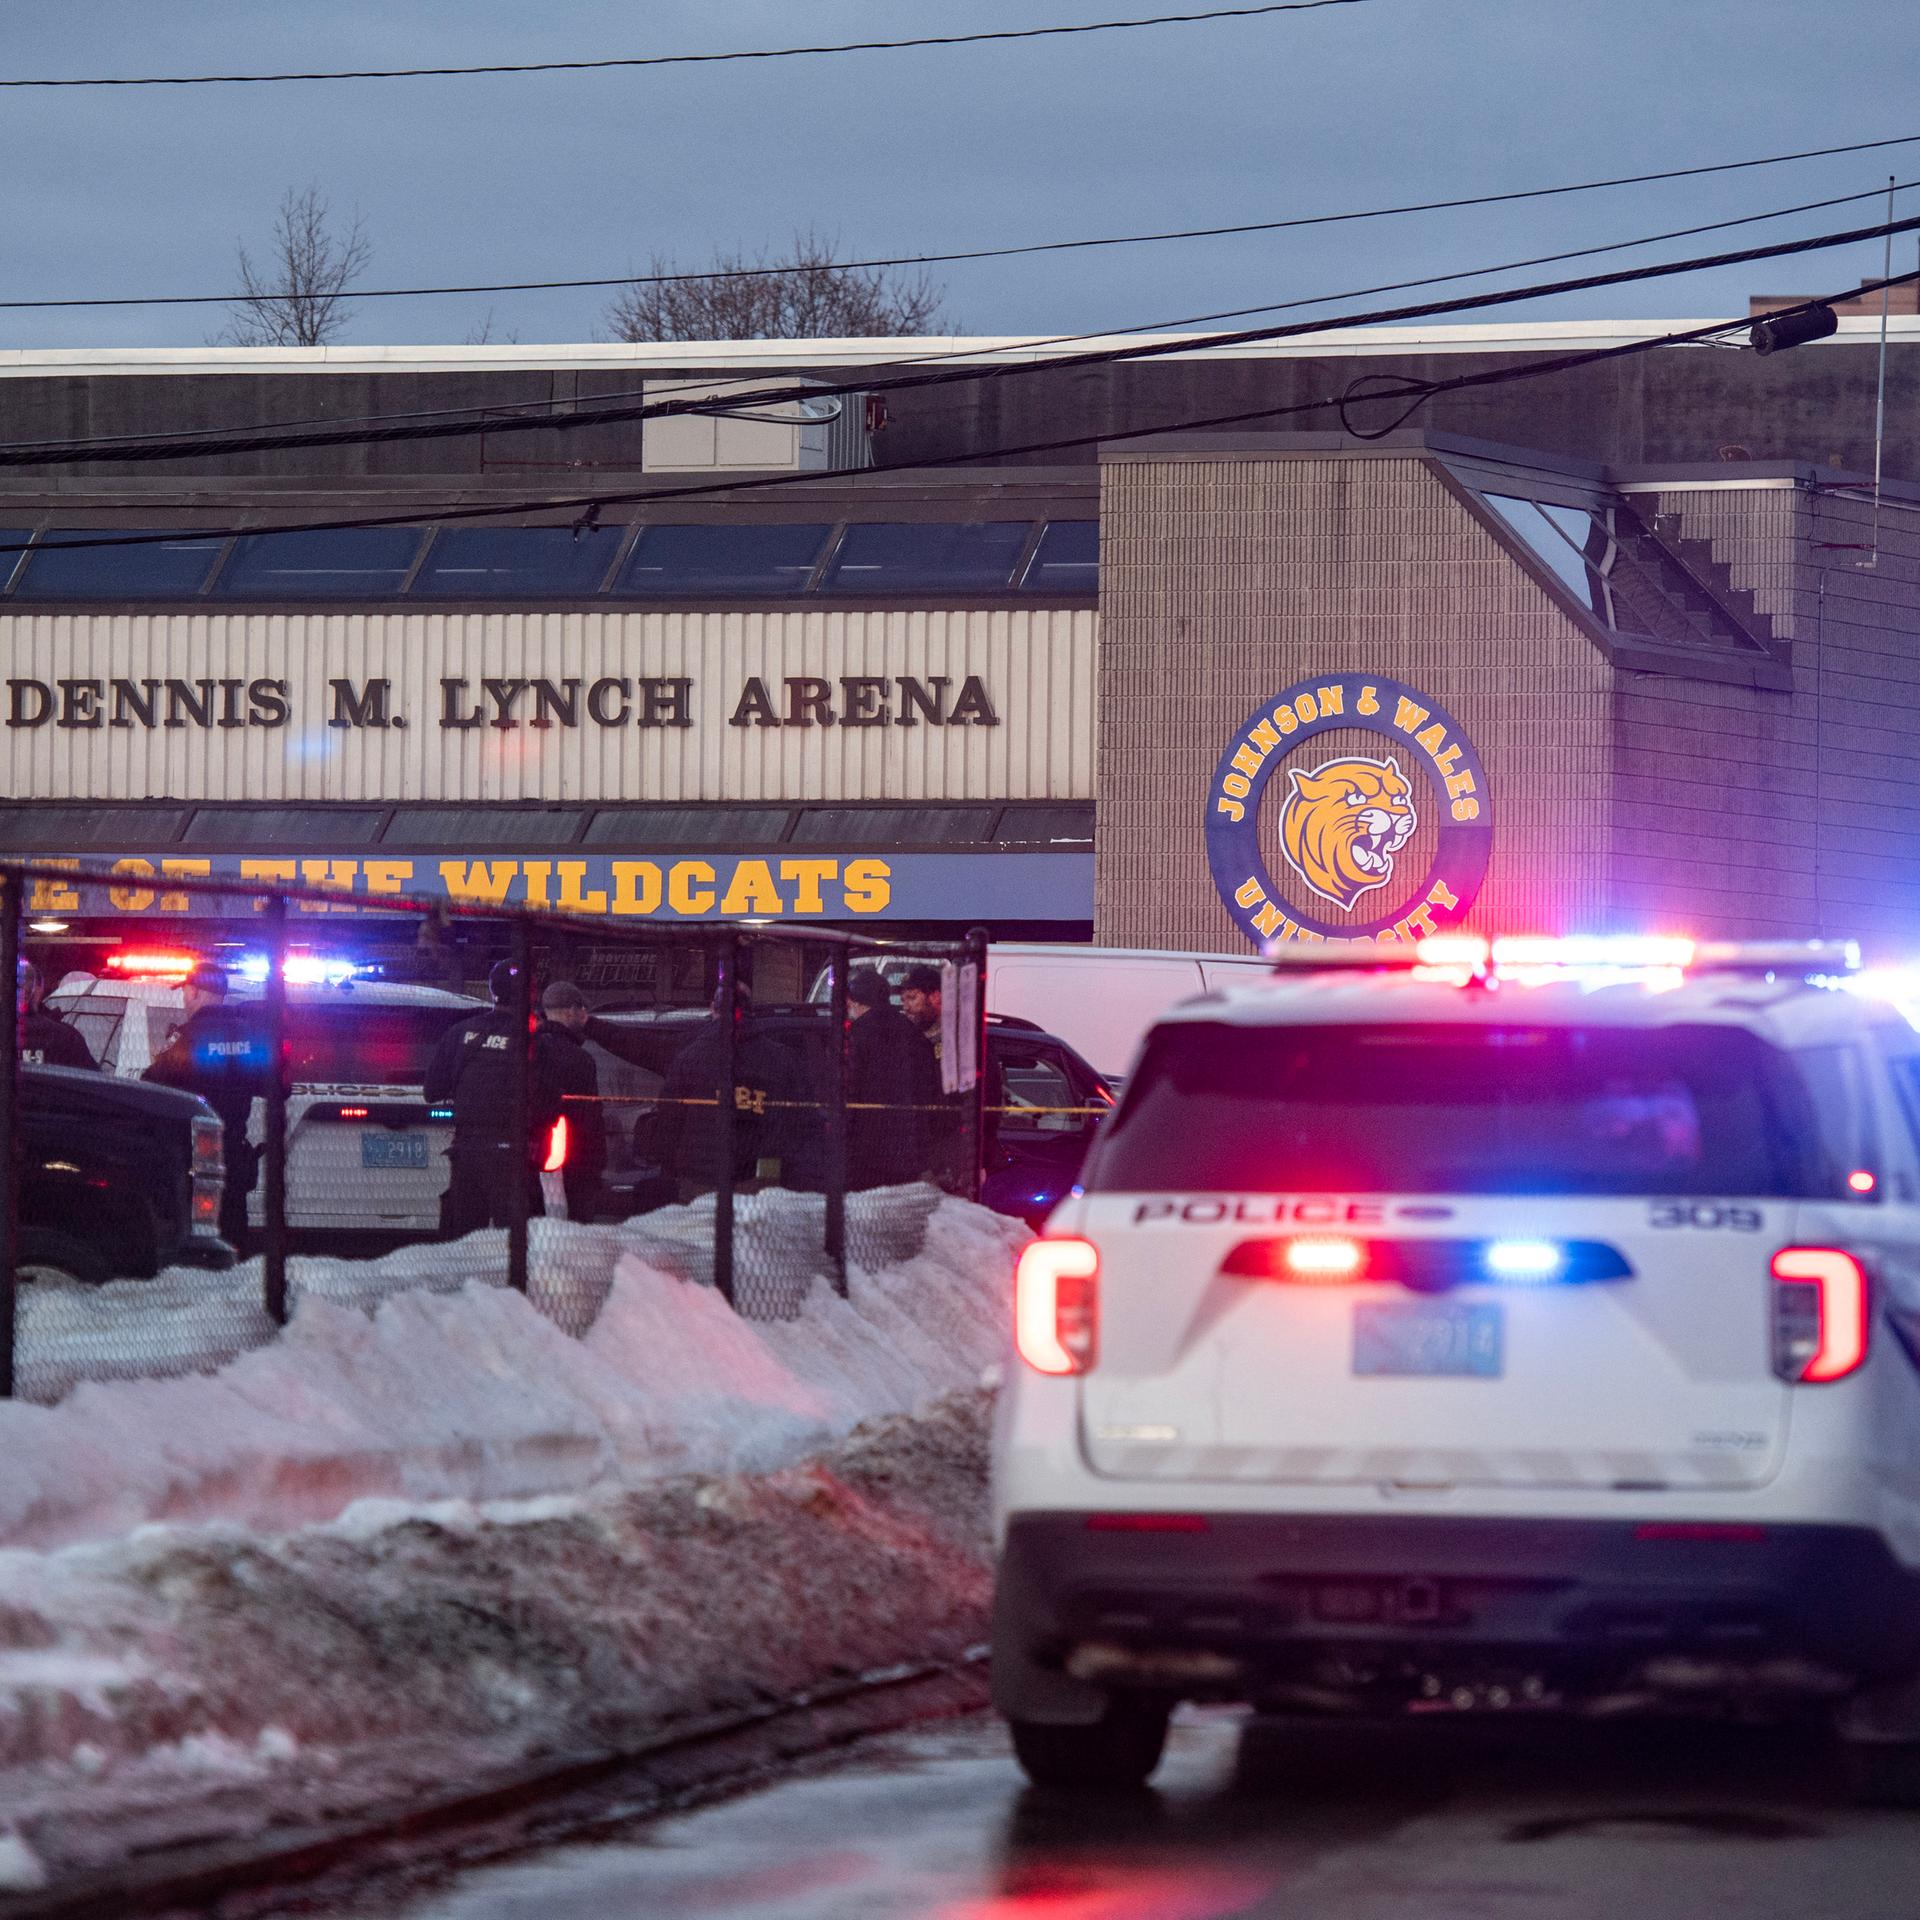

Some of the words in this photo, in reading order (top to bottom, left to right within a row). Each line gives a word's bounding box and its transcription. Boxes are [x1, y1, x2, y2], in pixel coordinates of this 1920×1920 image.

[6, 679, 290, 728] DENNIS
[328, 678, 406, 728] M.
[439, 677, 693, 728] LYNCH
[728, 675, 1000, 727] ARENA
[1217, 685, 1344, 823] JOHNSON
[1357, 686, 1380, 715] &
[1393, 695, 1480, 821] WALES
[241, 859, 413, 912] THE
[439, 858, 891, 914] WILDCATS
[208, 1041, 251, 1056] POLICE
[1133, 1200, 1386, 1225] POLICE
[1648, 1204, 1766, 1233] 309
